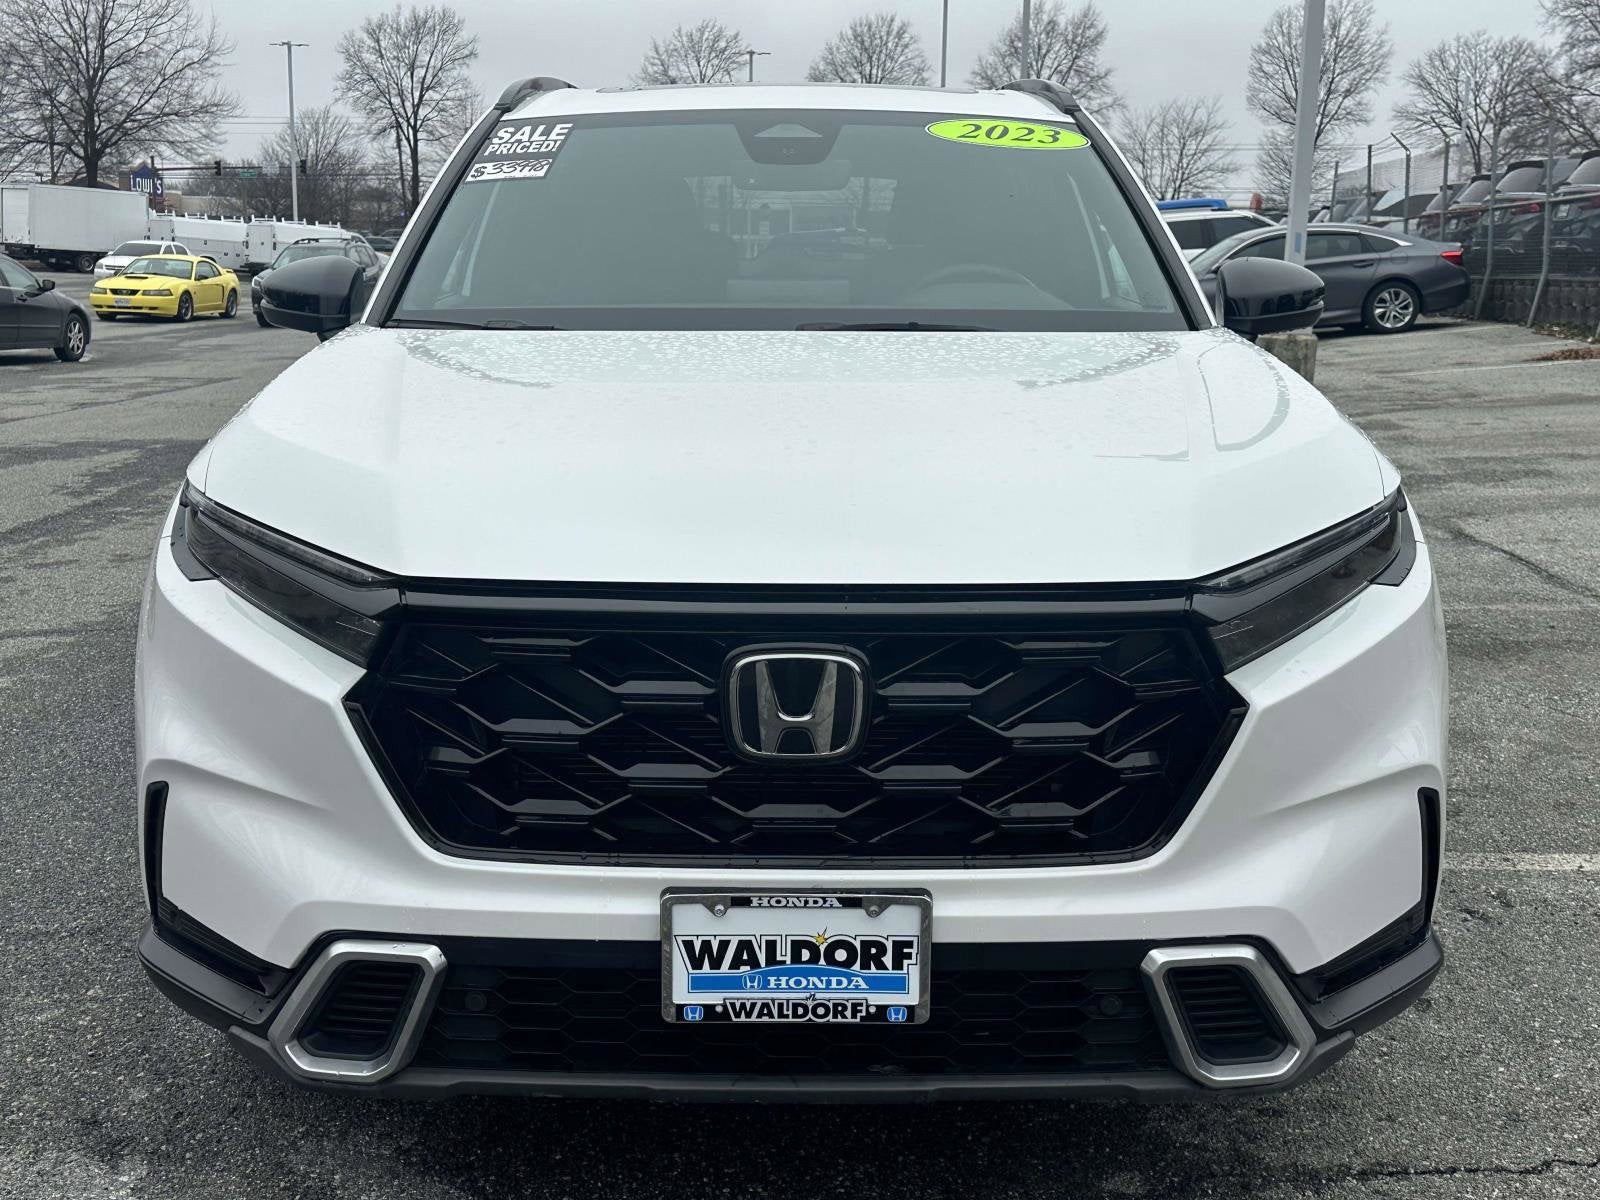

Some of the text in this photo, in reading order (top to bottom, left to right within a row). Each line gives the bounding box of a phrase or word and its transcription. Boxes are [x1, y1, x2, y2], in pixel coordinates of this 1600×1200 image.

[492, 124, 573, 143] SALE
[957, 123, 1061, 144] 2023
[484, 140, 561, 156] PRICED!
[750, 897, 843, 908] HONDA
[681, 939, 914, 971] WALDORF
[767, 976, 869, 989] HONDA
[728, 1001, 863, 1019] WALDORF
